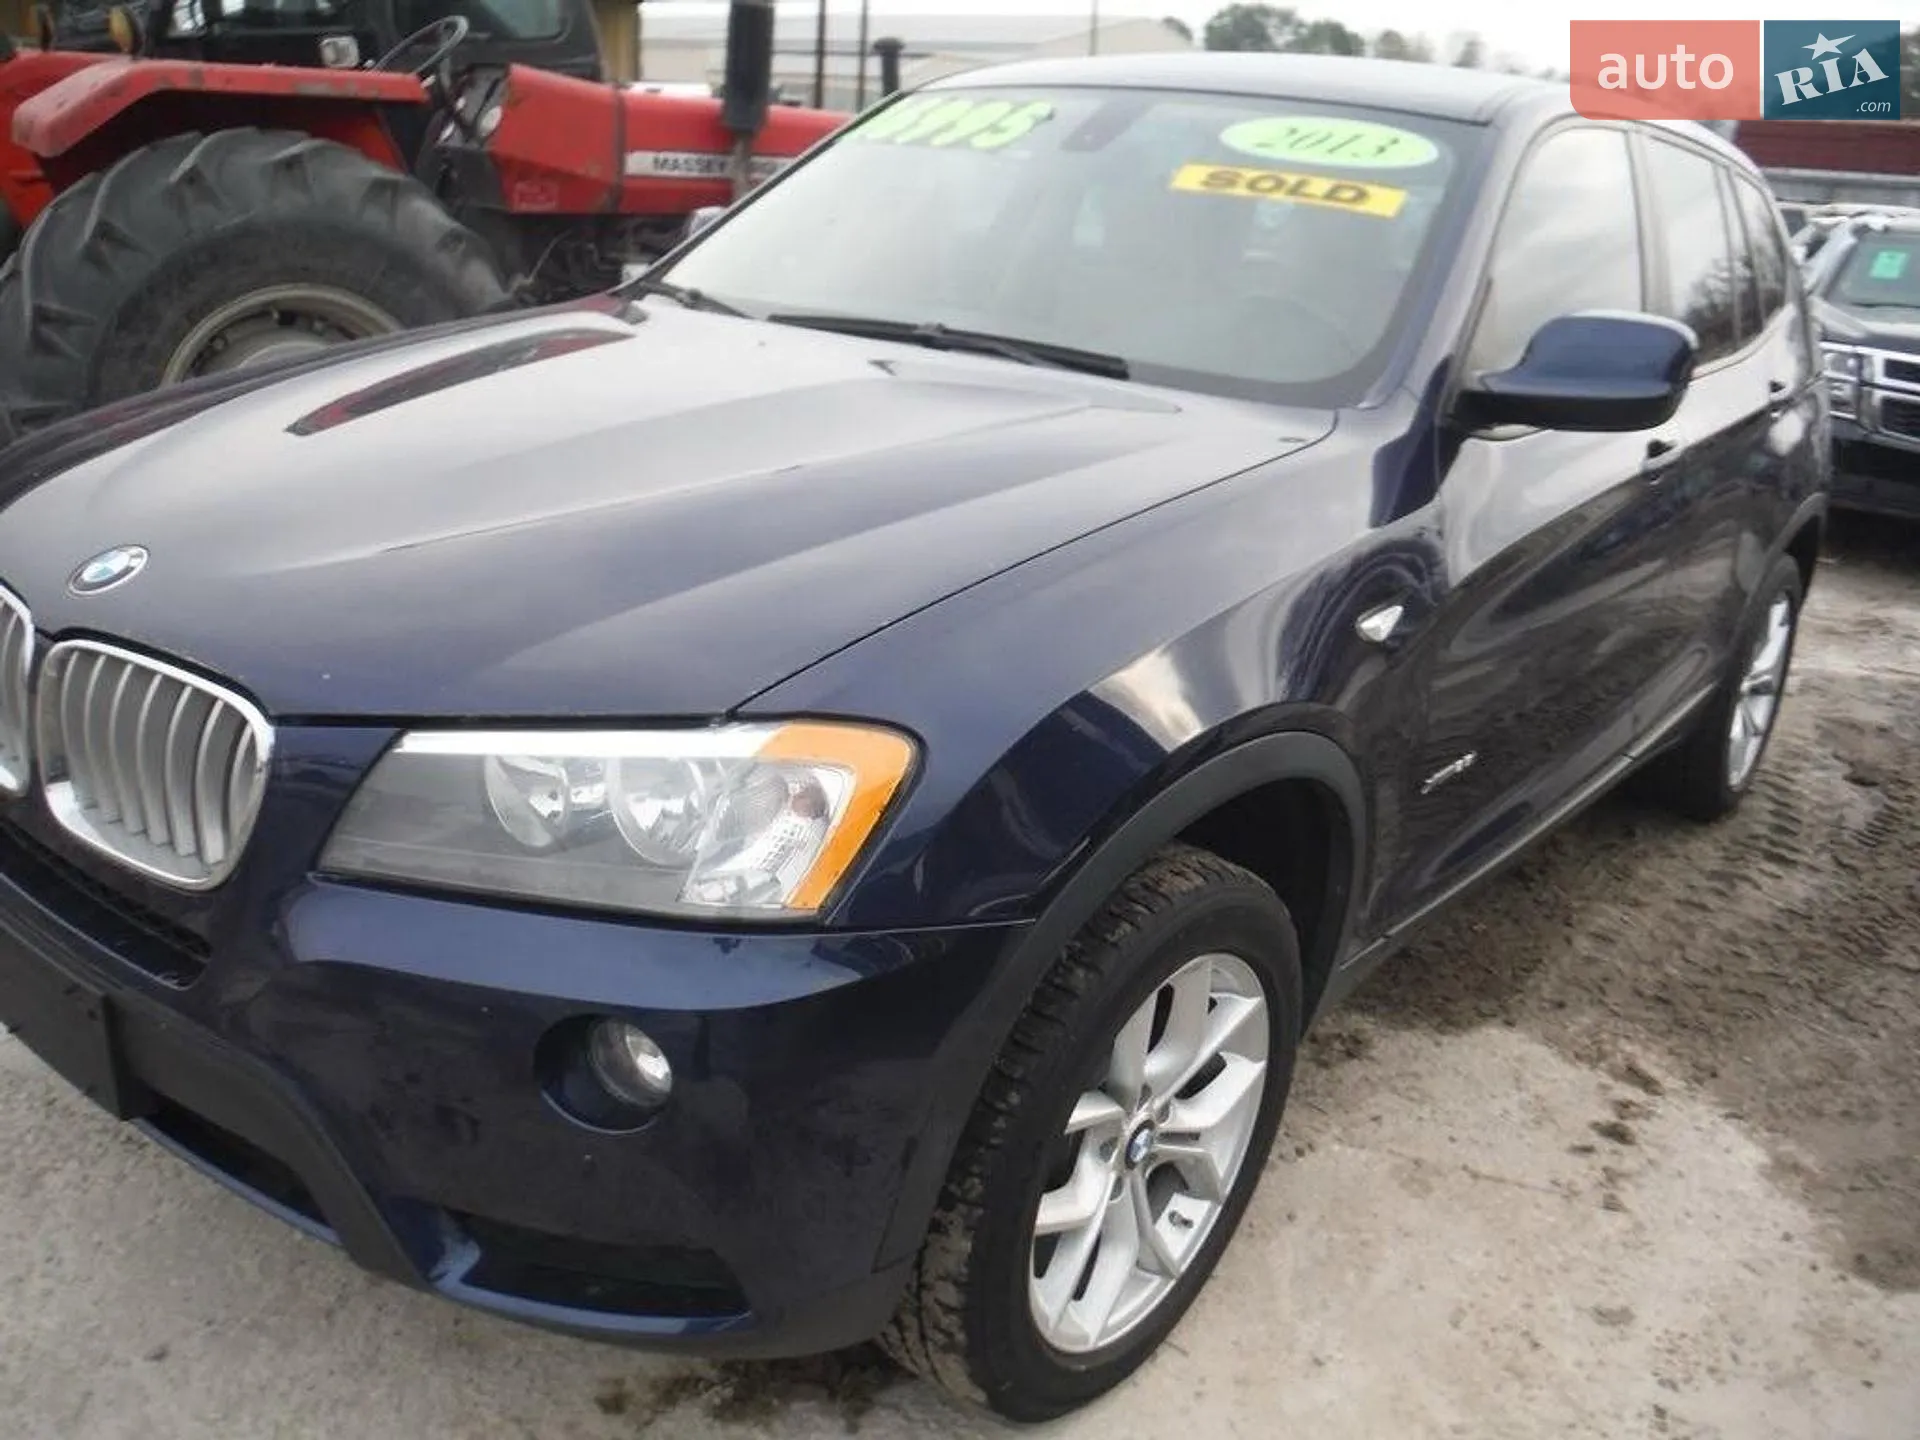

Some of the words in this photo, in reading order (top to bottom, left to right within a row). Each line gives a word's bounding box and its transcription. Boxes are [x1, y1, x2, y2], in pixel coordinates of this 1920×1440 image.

[1253, 125, 1402, 161] 2013
[653, 156, 727, 174] MASSEY
[1200, 169, 1369, 205] SOLD
